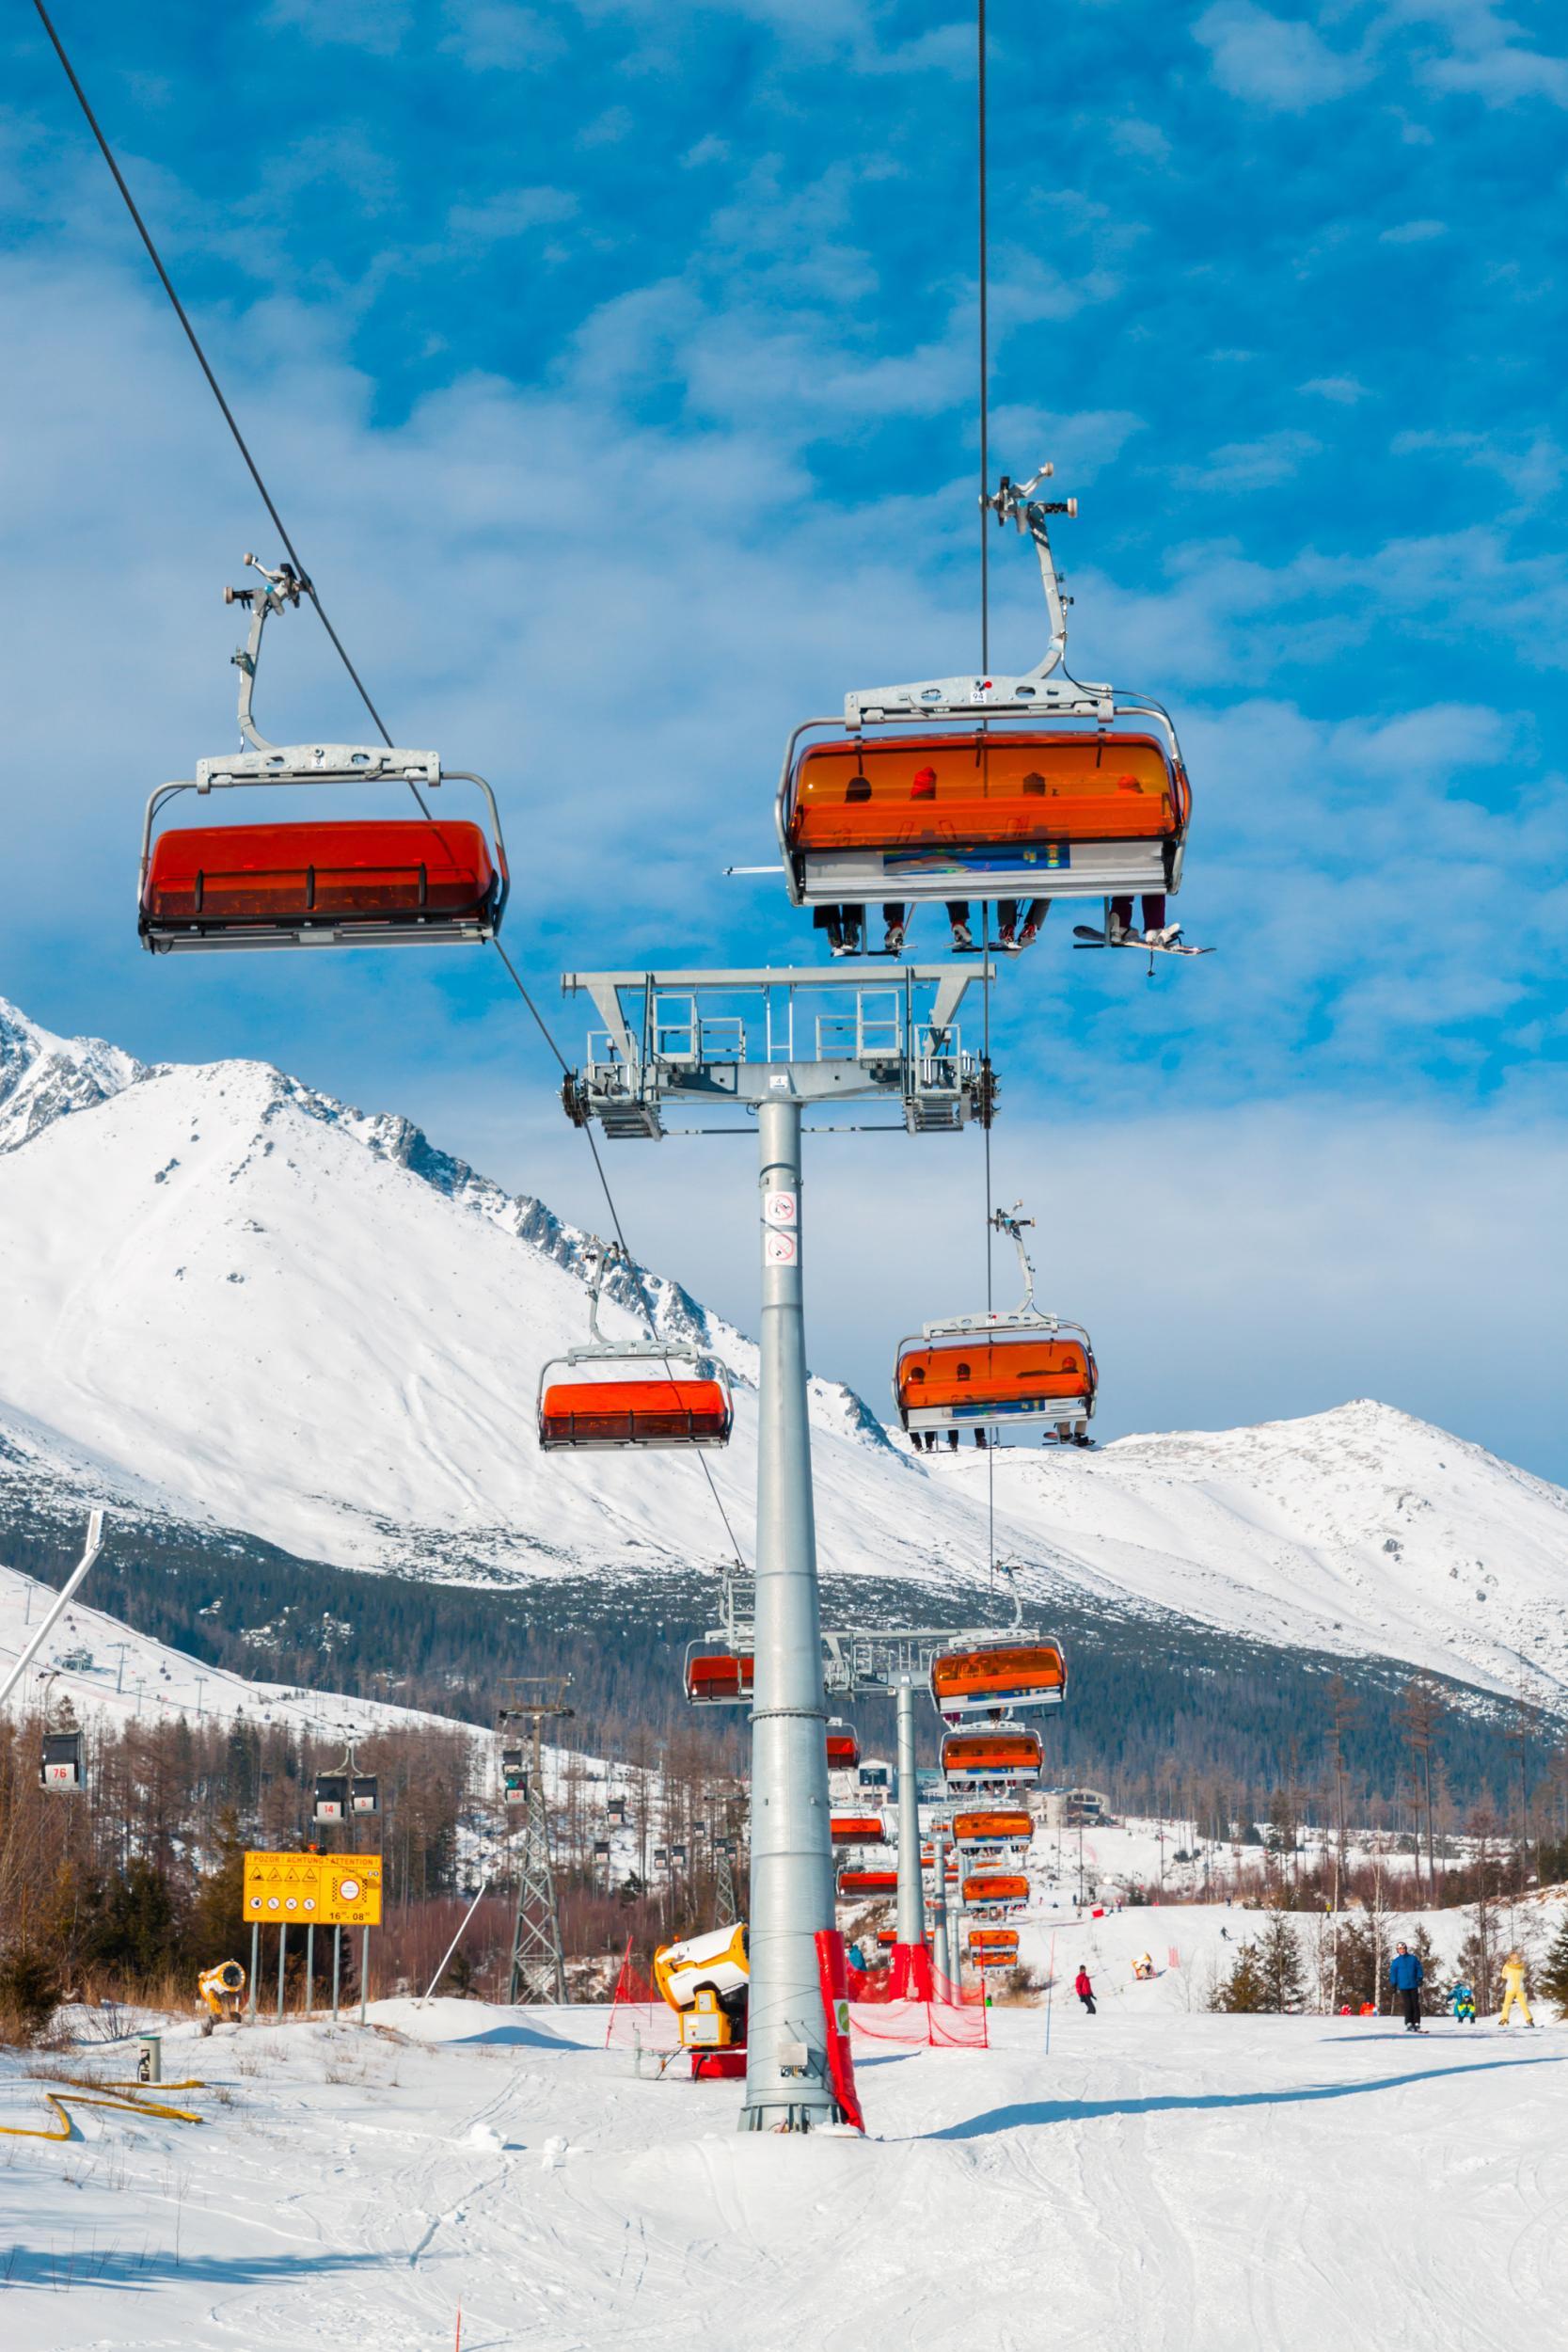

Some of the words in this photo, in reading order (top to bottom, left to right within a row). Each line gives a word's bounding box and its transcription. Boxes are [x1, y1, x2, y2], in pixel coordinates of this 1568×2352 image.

[53, 1768, 67, 1779] 76
[324, 1804, 334, 1813] 14
[287, 1856, 324, 1865] ACHTUNG
[330, 1857, 373, 1866] ATTENTION
[329, 1912, 341, 1920] 16
[353, 1913, 364, 1921] 08
